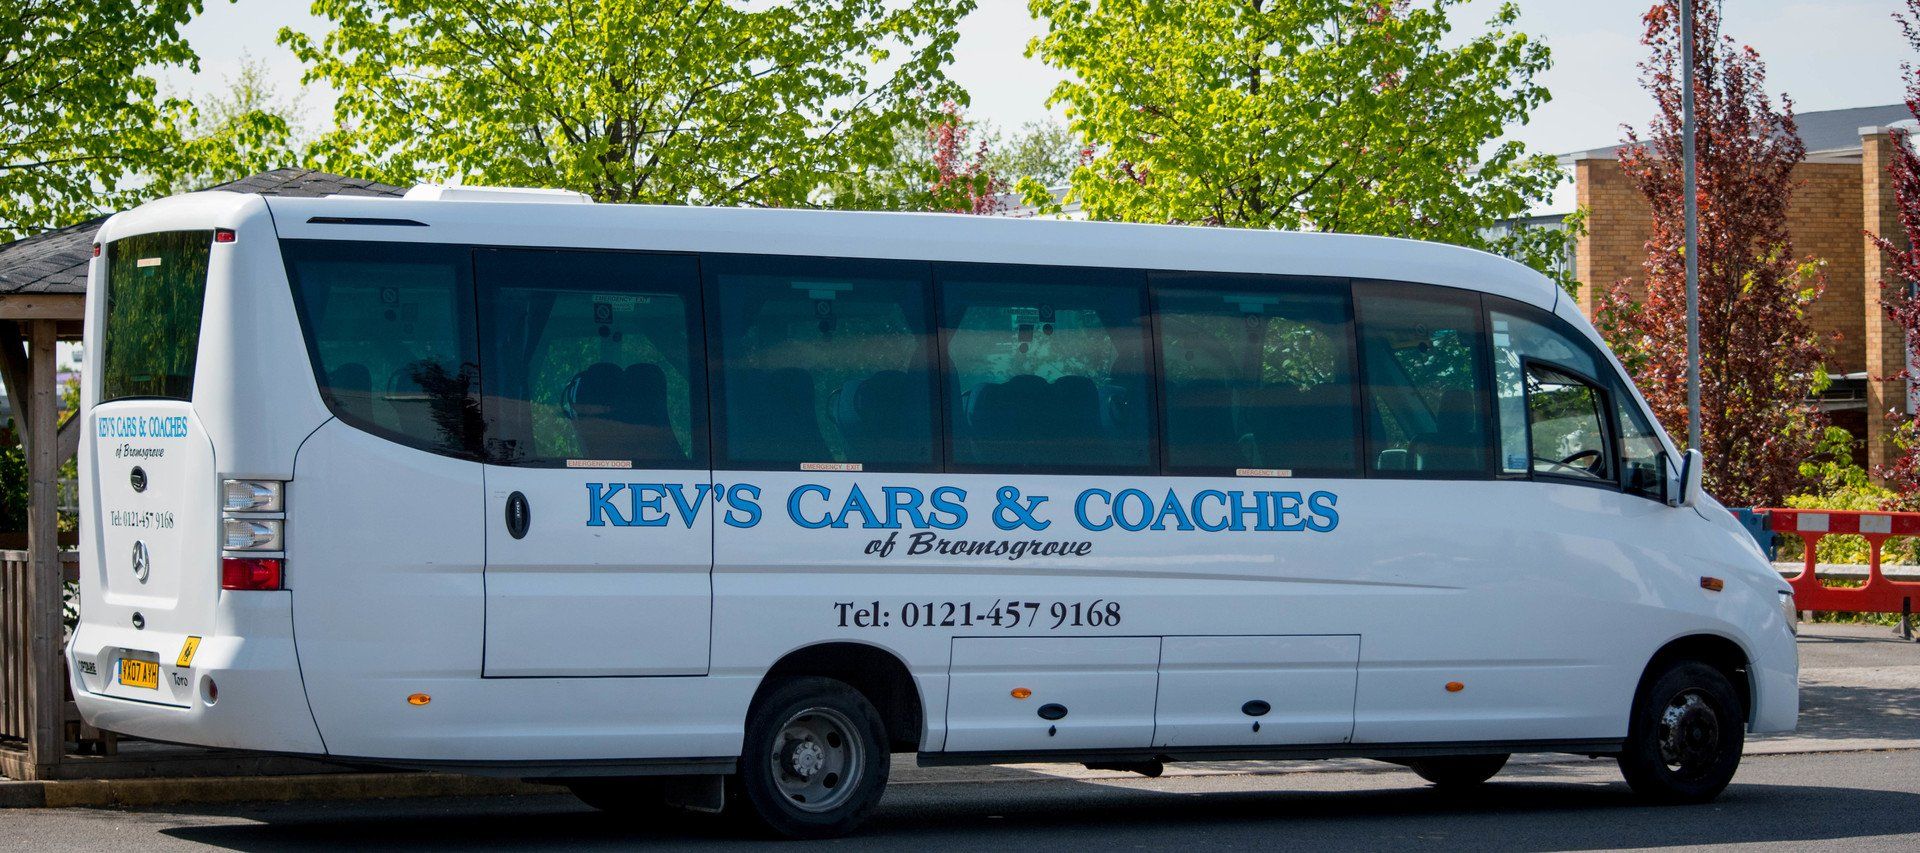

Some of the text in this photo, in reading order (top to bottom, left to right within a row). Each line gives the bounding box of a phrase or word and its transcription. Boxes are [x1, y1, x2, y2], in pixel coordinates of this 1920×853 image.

[116, 416, 137, 437] CARS
[138, 416, 147, 437] &
[149, 416, 188, 437] COACHES
[115, 443, 165, 460] of Bromsgrove
[586, 483, 1339, 532] KEV'S CARS & COACHES
[111, 510, 174, 529] Tel: 0121-457 9168
[864, 531, 1093, 561] of Bromsgrove
[834, 599, 1122, 629] Tel: 0121-457 9168
[172, 672, 188, 687] Toro
